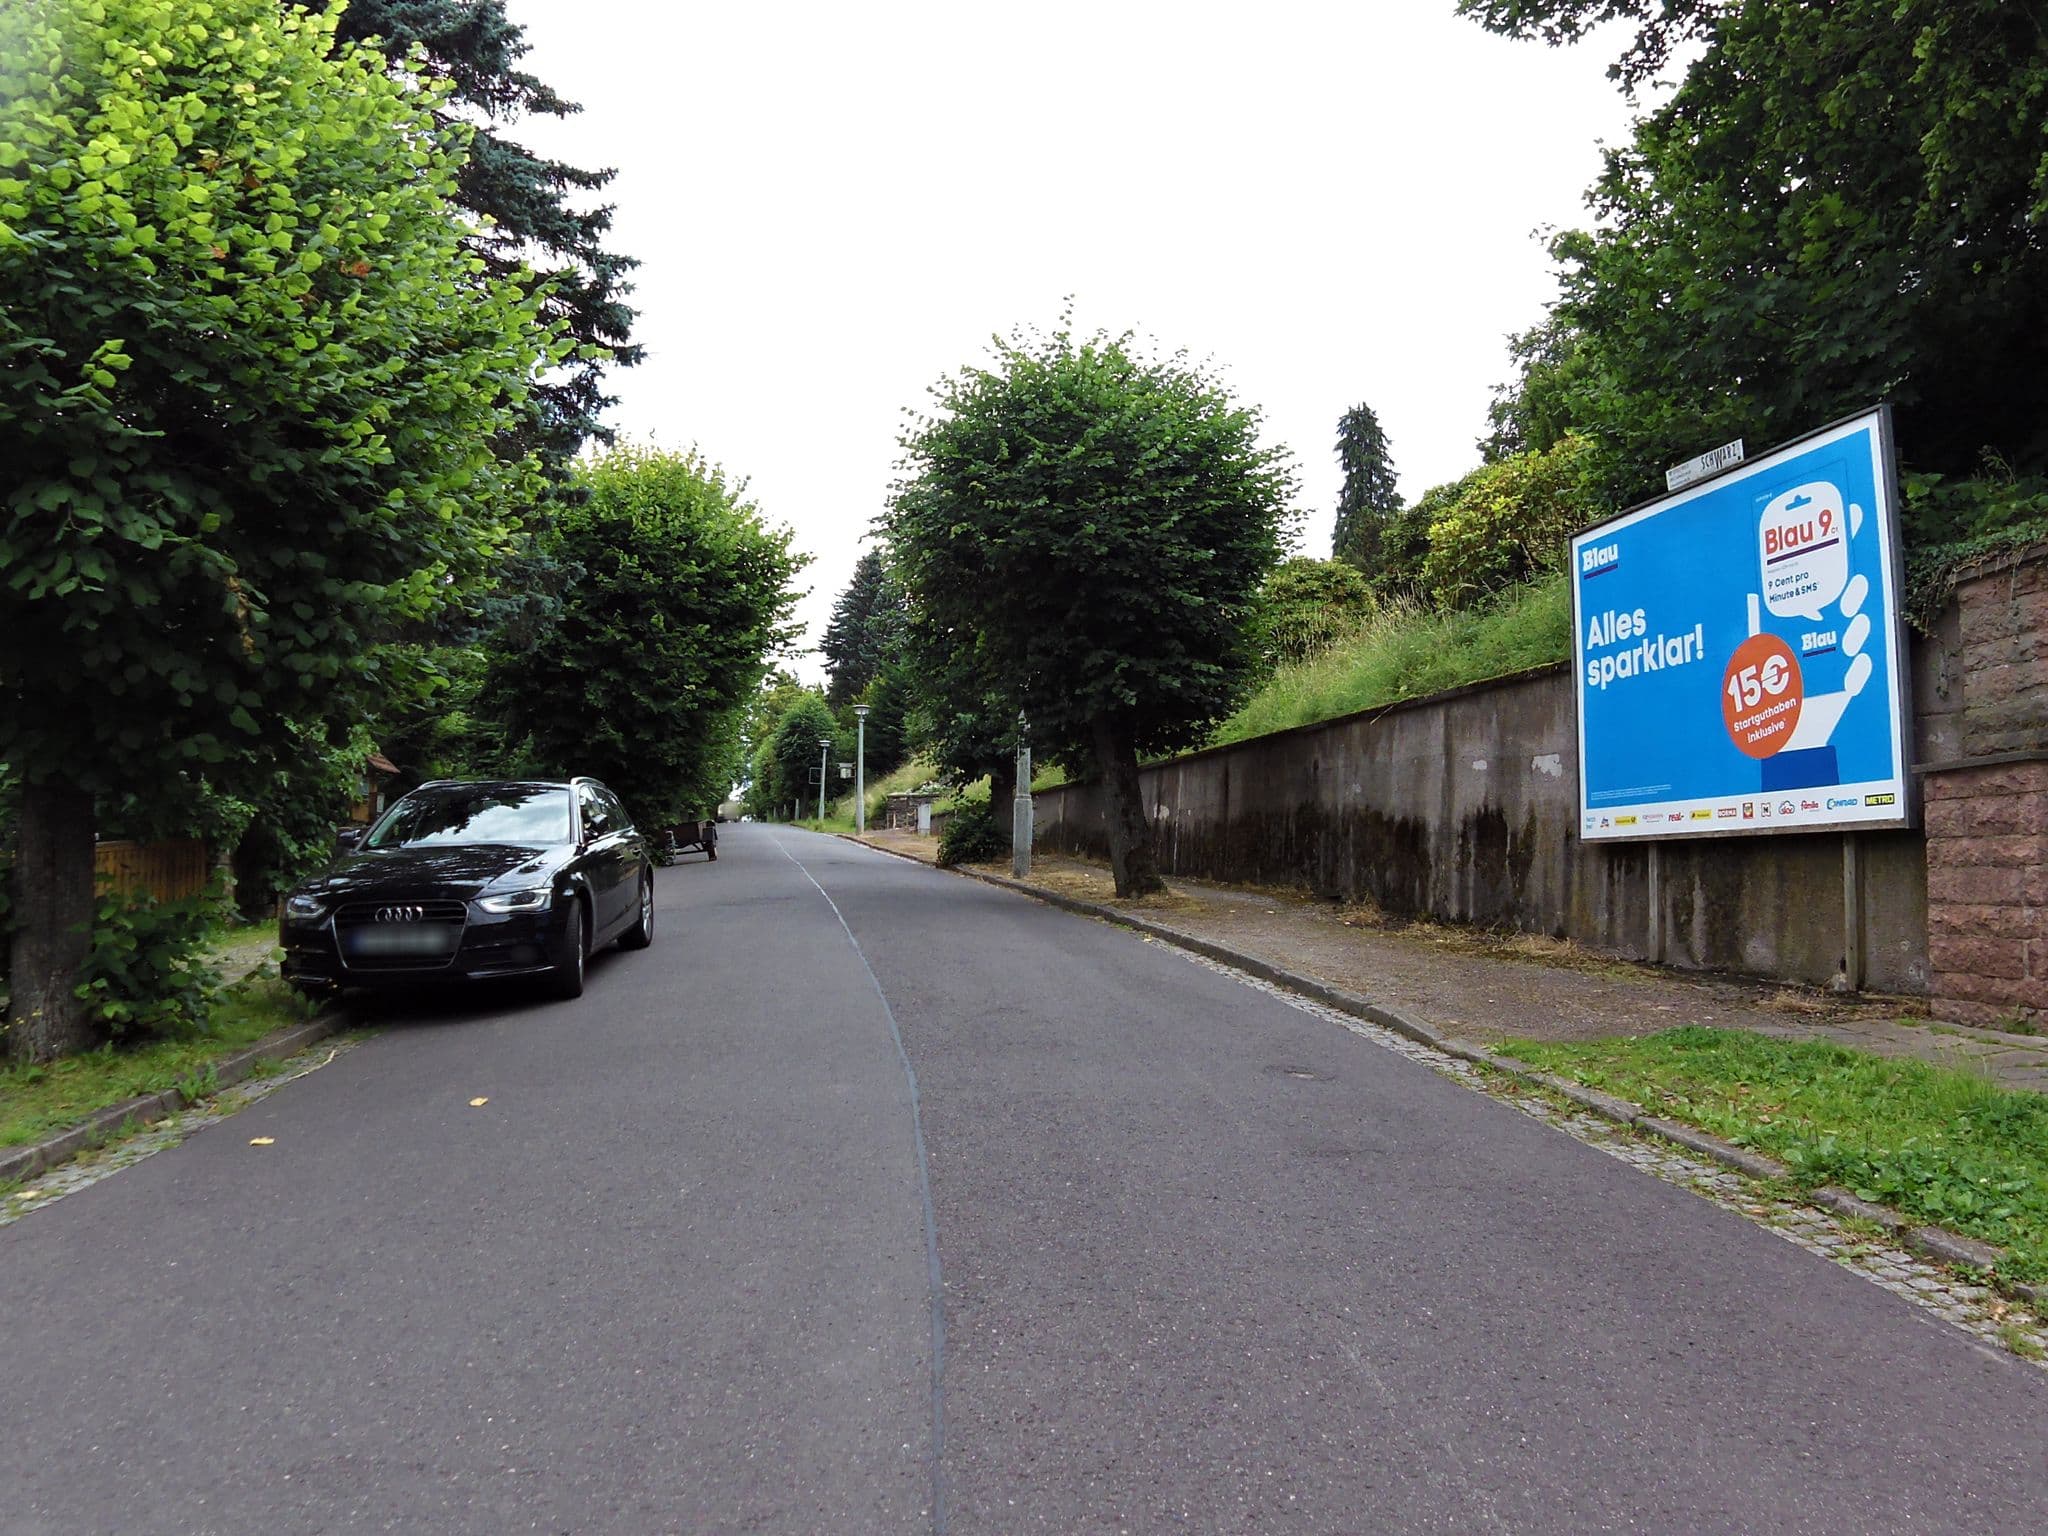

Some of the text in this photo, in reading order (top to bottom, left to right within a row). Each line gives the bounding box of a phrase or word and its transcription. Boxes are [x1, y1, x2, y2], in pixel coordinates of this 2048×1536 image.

[1765, 521, 1814, 555] Blau
[1818, 509, 1833, 537] 9
[1582, 544, 1619, 571] Blau
[1767, 571, 1810, 591] 9 Cent pro
[1769, 590, 1794, 604] Minute
[1801, 582, 1818, 594] SMS
[1587, 608, 1647, 650] Alles
[1801, 630, 1837, 651] Blau
[1587, 623, 1704, 690] sparklar!
[1727, 654, 1789, 713] 15€
[1733, 698, 1797, 732] Startguthaben
[1866, 795, 1893, 806] METRO
